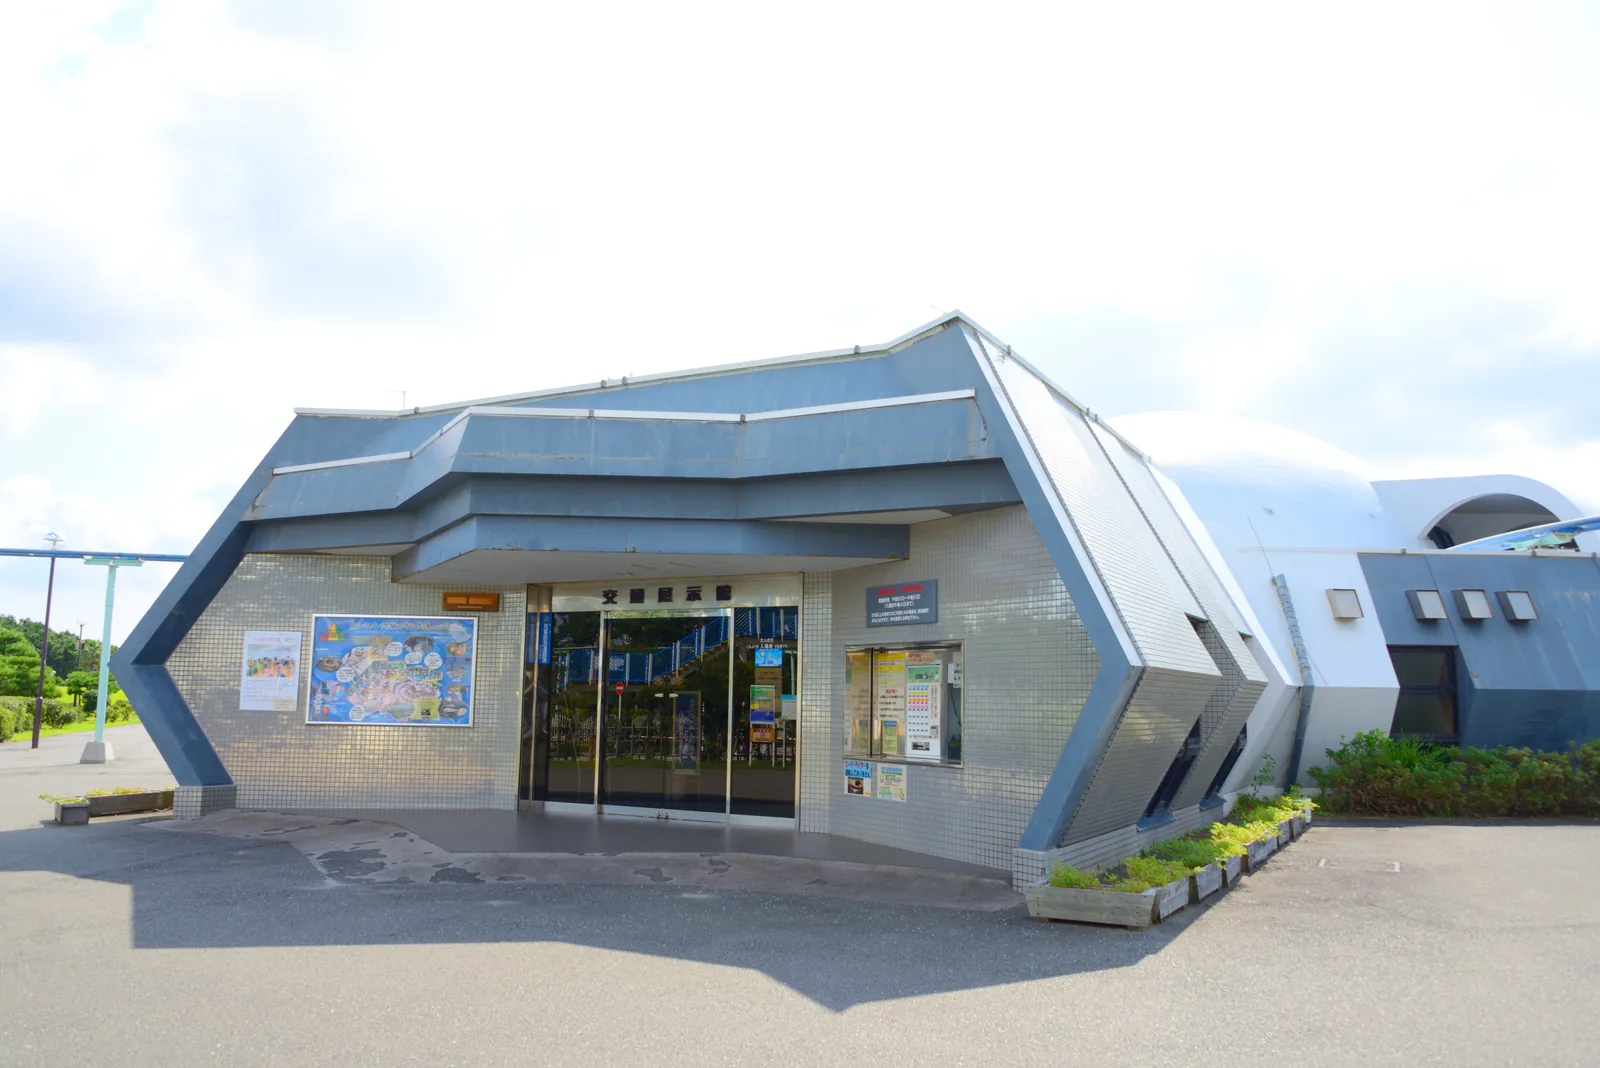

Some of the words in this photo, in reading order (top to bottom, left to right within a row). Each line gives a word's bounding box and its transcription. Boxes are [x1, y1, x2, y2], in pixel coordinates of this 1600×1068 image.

[602, 585, 732, 605] 交通展示館
